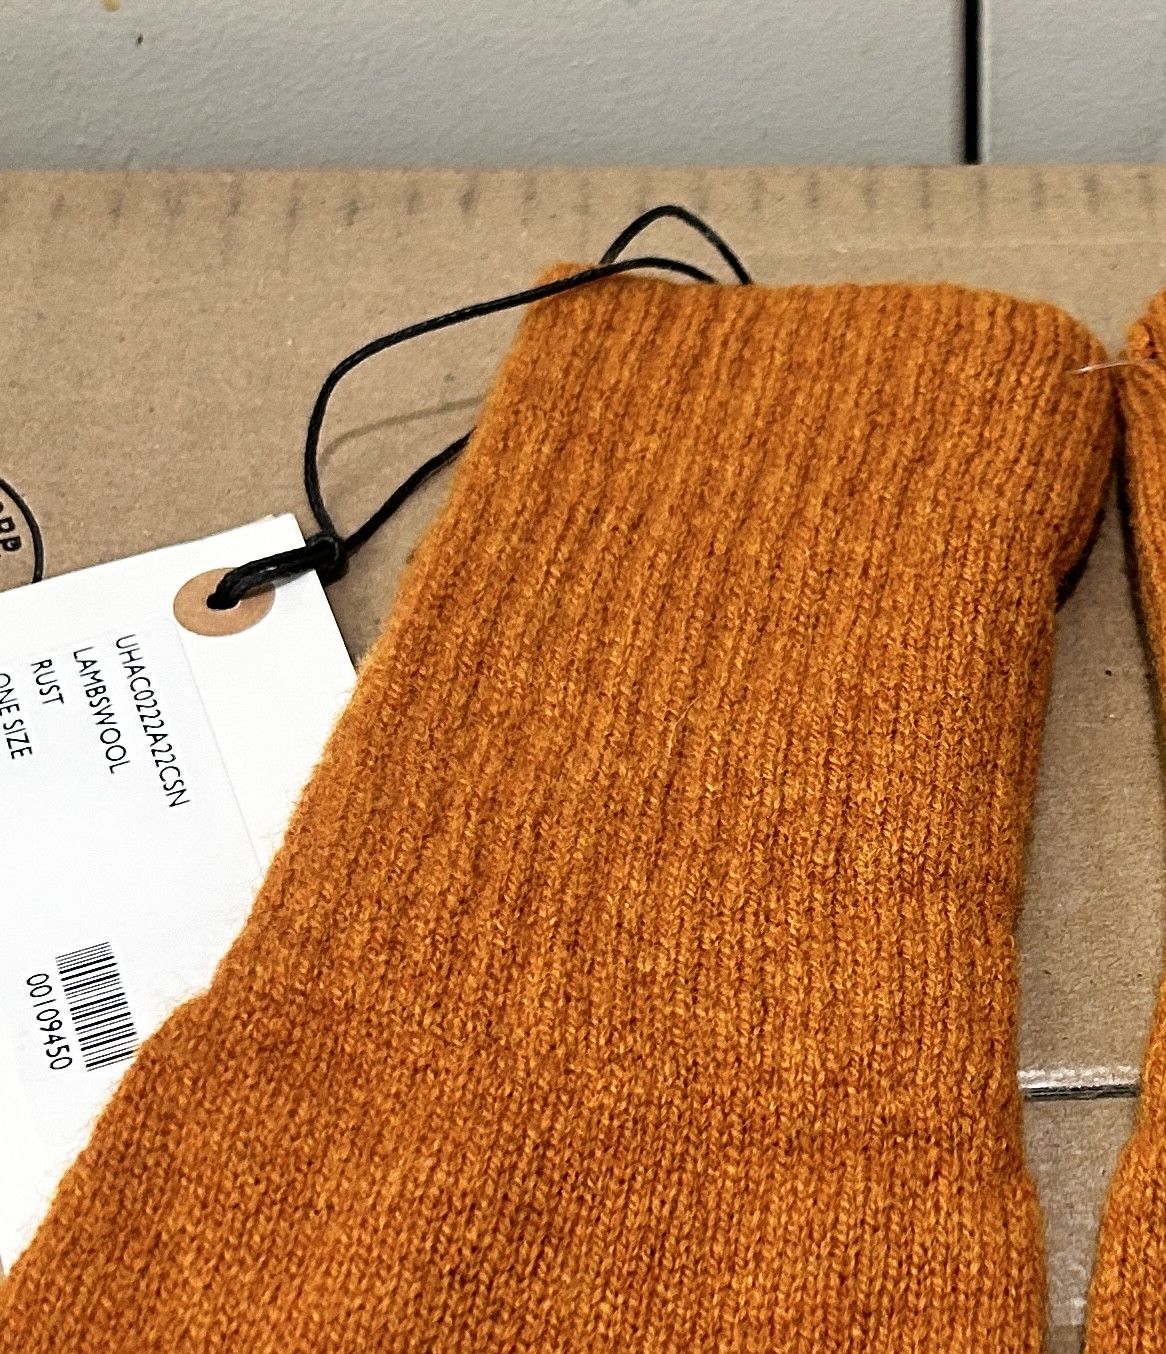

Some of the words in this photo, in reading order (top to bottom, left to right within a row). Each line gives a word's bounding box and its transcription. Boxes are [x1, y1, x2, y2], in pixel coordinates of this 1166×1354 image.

[30, 658, 65, 705] RUST
[73, 646, 131, 775] LAMBSWOOL
[115, 634, 190, 808] UHAC0222A22CSN
[2, 718, 33, 760] SIZE
[26, 973, 73, 1071] 00109450
